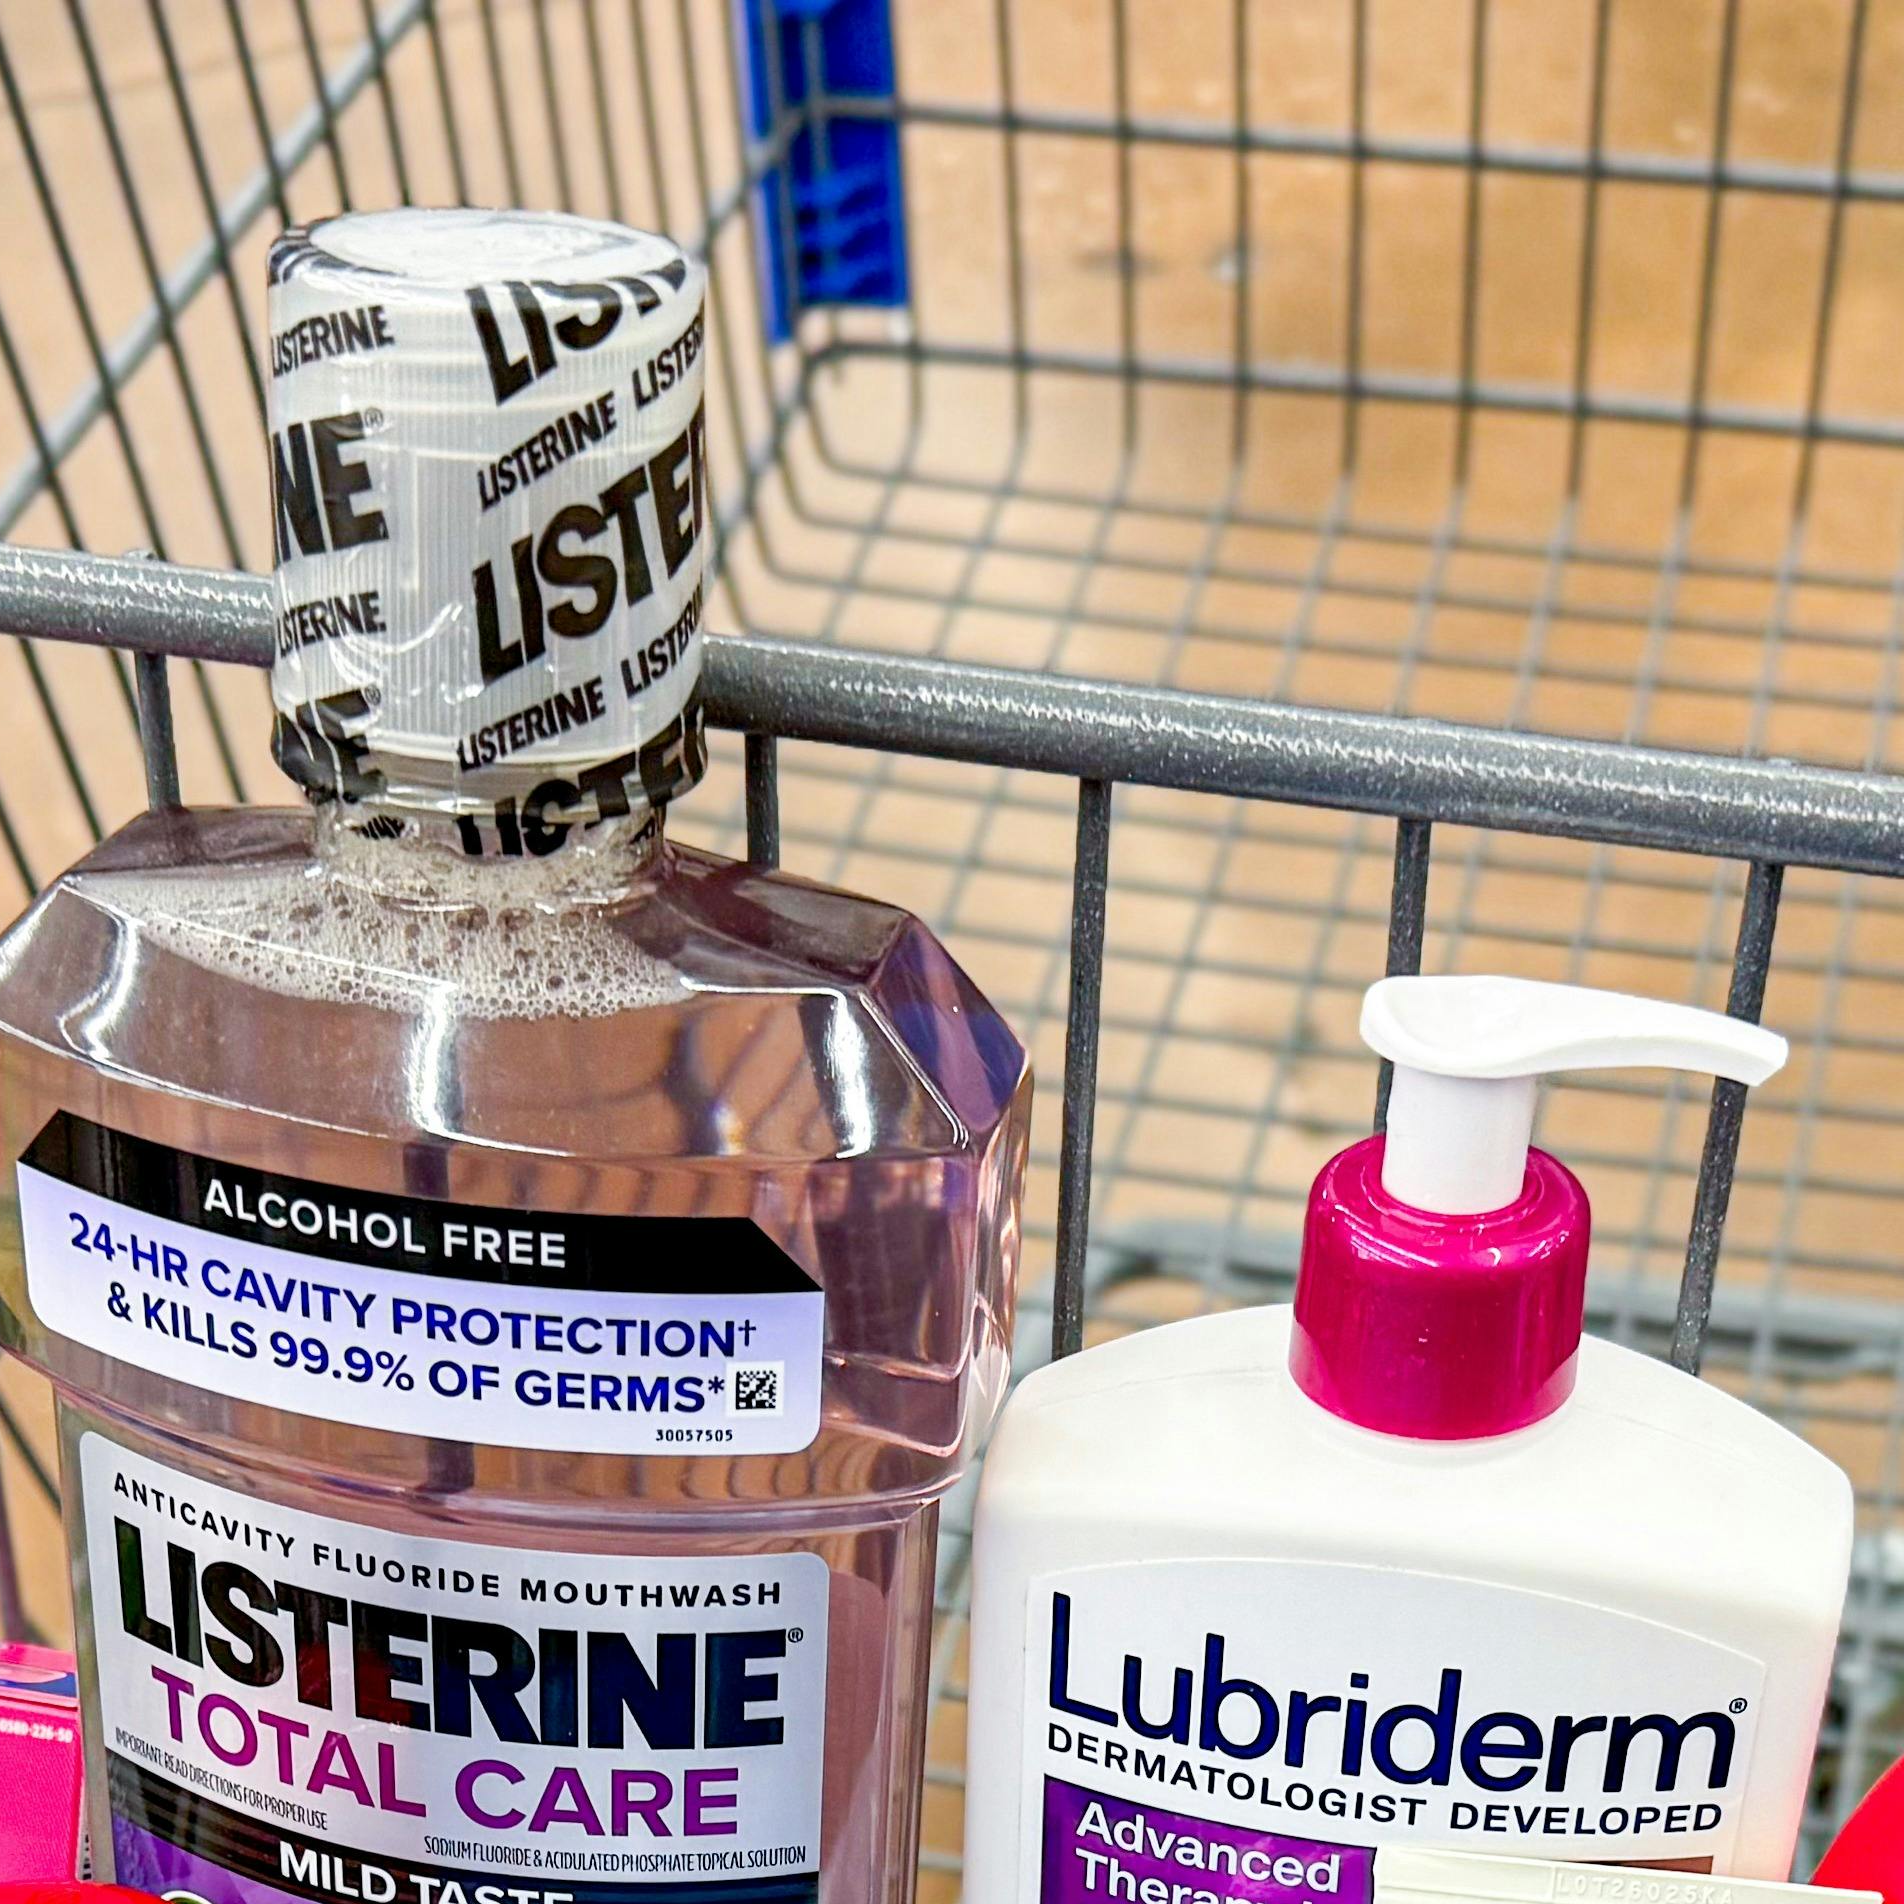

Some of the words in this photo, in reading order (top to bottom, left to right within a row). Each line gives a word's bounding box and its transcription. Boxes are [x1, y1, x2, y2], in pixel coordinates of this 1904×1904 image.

[477, 392, 617, 512] LISTERINE
[457, 677, 606, 772] LISTERINE
[68, 1213, 190, 1286] 24-HR
[201, 1260, 377, 1331] CAVITY
[204, 1179, 428, 1255] ALCOHOL
[443, 1224, 567, 1268] FREE
[106, 1283, 134, 1320] &
[143, 1292, 259, 1360] KILLS
[270, 1332, 415, 1392] 99.9%
[428, 1361, 502, 1400] OF
[655, 1429, 733, 1442] 30057505
[114, 1472, 297, 1559] ANTICAVITY
[312, 1544, 501, 1598] FLUORIDE
[520, 1580, 782, 1608] MOUTHWASH
[151, 1665, 427, 1819] TOTAL
[454, 1759, 740, 1838] CARE
[1046, 1723, 1428, 1828] DERMATOLOGIST
[1449, 1801, 1722, 1834] DEVELOPED
[280, 1841, 398, 1904] MILD
[1076, 1801, 1340, 1893] Advanced
